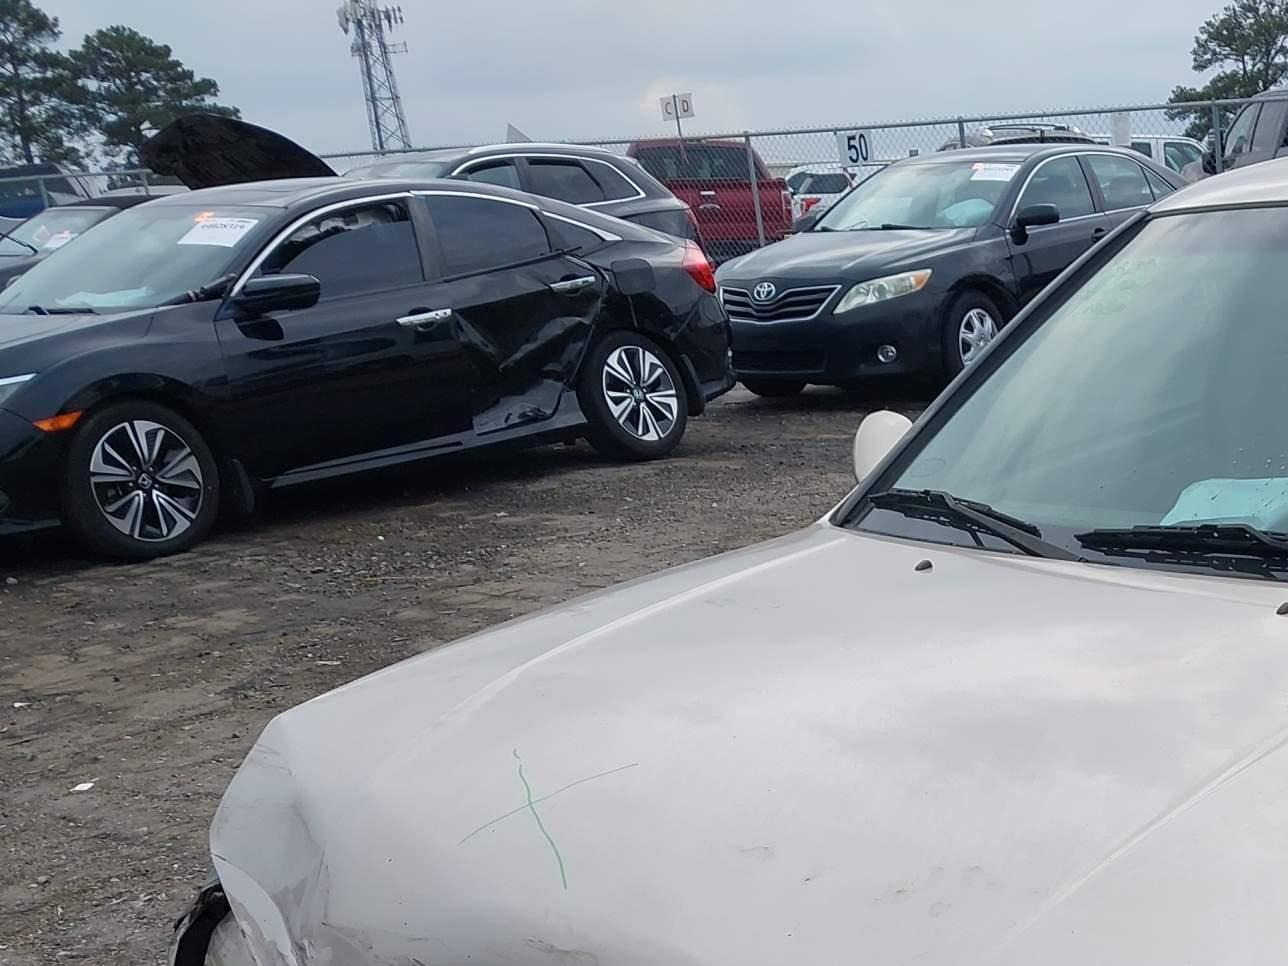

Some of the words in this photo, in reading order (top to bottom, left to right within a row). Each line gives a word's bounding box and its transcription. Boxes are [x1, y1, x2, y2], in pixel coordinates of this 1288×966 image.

[664, 102, 673, 115] C
[682, 99, 689, 113] D
[847, 133, 869, 163] 50
